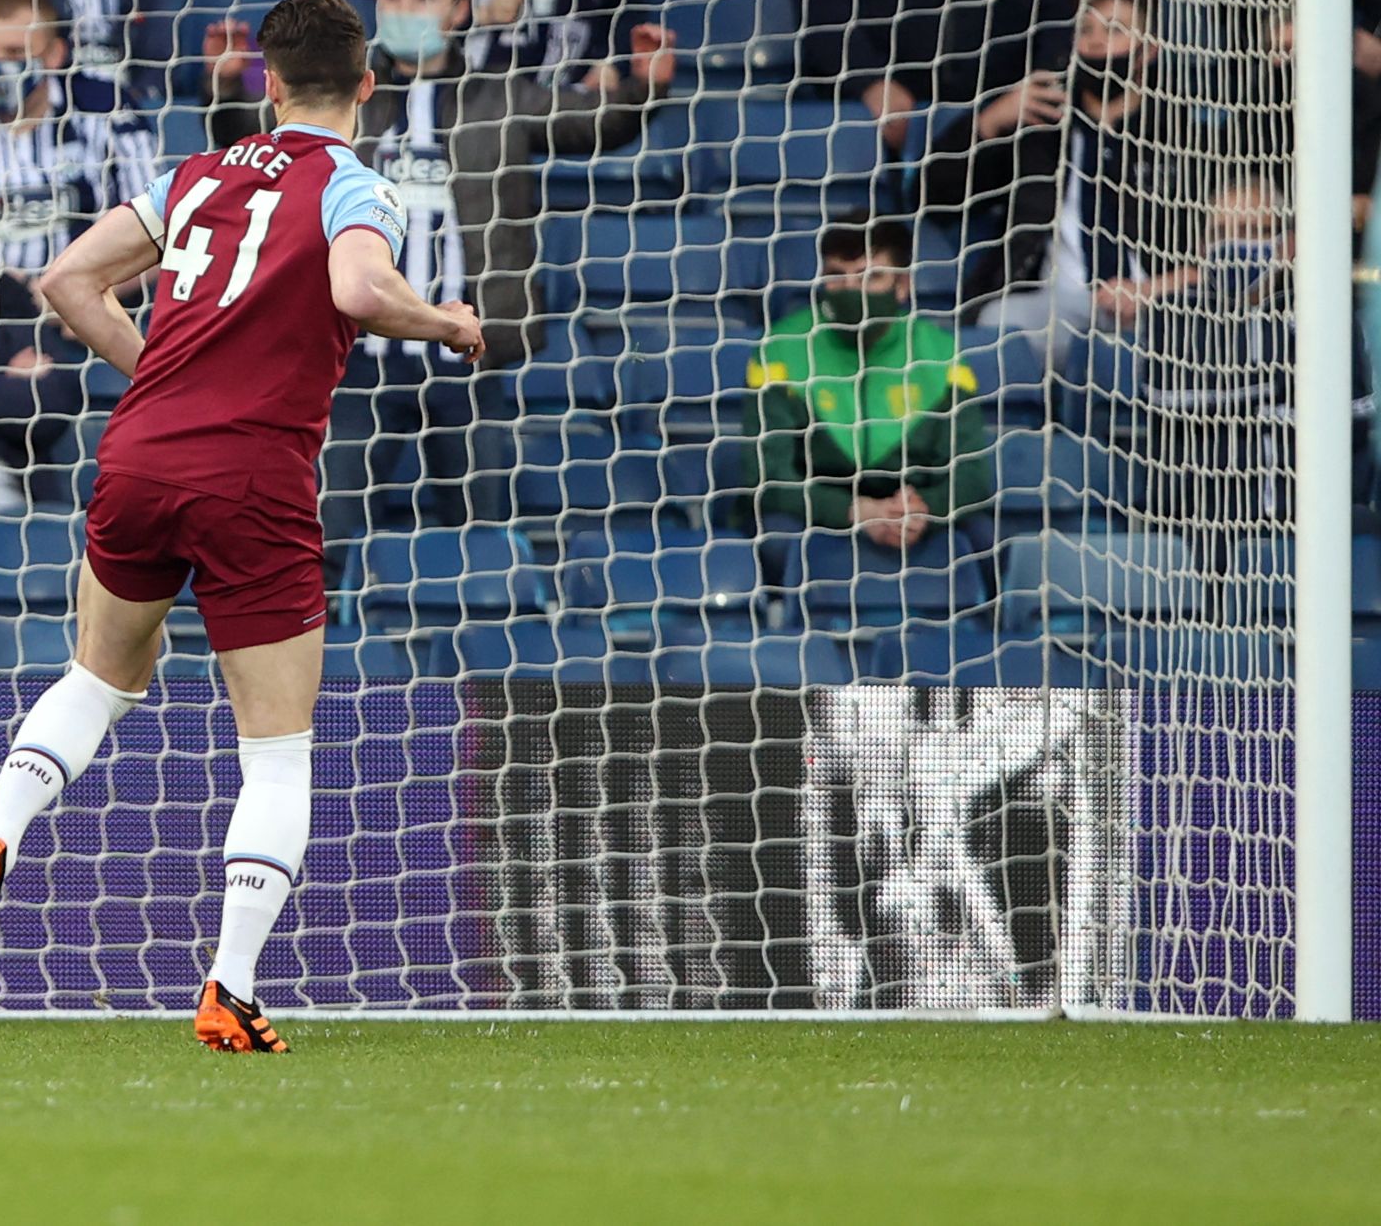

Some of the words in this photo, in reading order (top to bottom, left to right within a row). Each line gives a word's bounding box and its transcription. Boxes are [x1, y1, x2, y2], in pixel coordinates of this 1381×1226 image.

[221, 142, 293, 179] RICE
[381, 151, 451, 184] idea
[160, 176, 283, 308] 41
[9, 760, 52, 785] WHU
